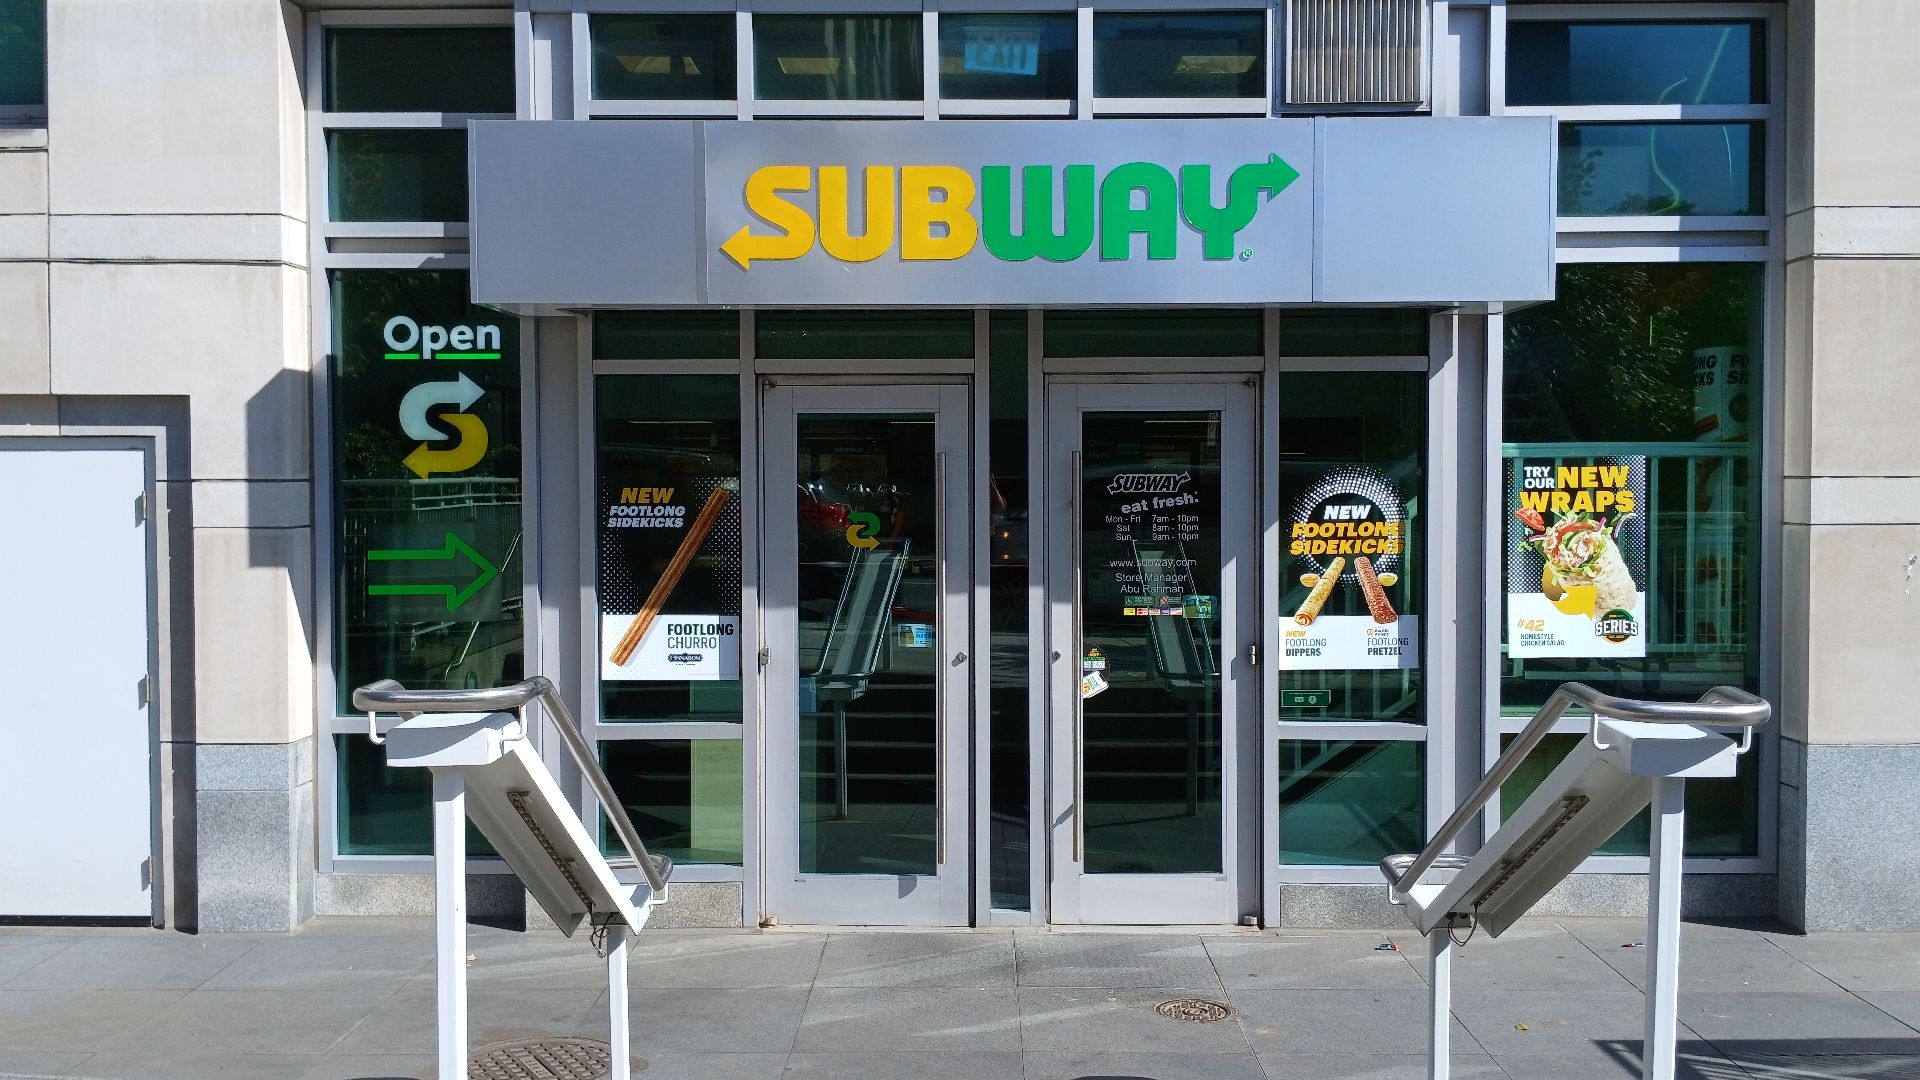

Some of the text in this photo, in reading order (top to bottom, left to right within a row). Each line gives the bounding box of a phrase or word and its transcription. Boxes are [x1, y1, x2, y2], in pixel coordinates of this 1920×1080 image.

[719, 153, 1300, 270] SUBWAY
[383, 315, 501, 359] Open
[1524, 466, 1550, 478] TRY
[1557, 466, 1629, 489] NEW
[1107, 470, 1191, 495] SUBWAY
[1525, 478, 1555, 489] OUR
[621, 488, 674, 503] NEW
[1520, 490, 1636, 513] WRAPS
[610, 505, 686, 517] FOOTLONG
[1121, 499, 1149, 514] eat
[1324, 505, 1371, 520] NEW
[607, 518, 684, 528] SIDEKICKS
[1105, 515, 1122, 523] Mon
[1130, 515, 1141, 523] Fri
[1152, 515, 1169, 523] 7am
[1177, 514, 1199, 524] 10pm
[1116, 524, 1130, 532] Sat
[1152, 524, 1170, 532] 8am
[1177, 523, 1199, 533] 10pm
[1292, 522, 1405, 538] FOOTLONG
[1116, 533, 1132, 541] Sun
[1152, 533, 1170, 541] 9am
[1177, 532, 1199, 542] 10pm
[1290, 539, 1404, 556] SIDEKICKS
[1109, 559, 1197, 568] www.subway.com
[1115, 573, 1188, 584] Store Manager
[1120, 585, 1139, 593] Abu
[668, 624, 734, 635] FOOTLONG
[1517, 619, 1545, 632] #42
[1595, 620, 1639, 636] SERIES
[668, 637, 717, 649] CHURRO
[1285, 639, 1327, 647] FOOTLONG
[1367, 638, 1409, 646] FOOTLONG
[1286, 648, 1322, 657] DIPPERS
[1367, 647, 1403, 656] PRETZEL
